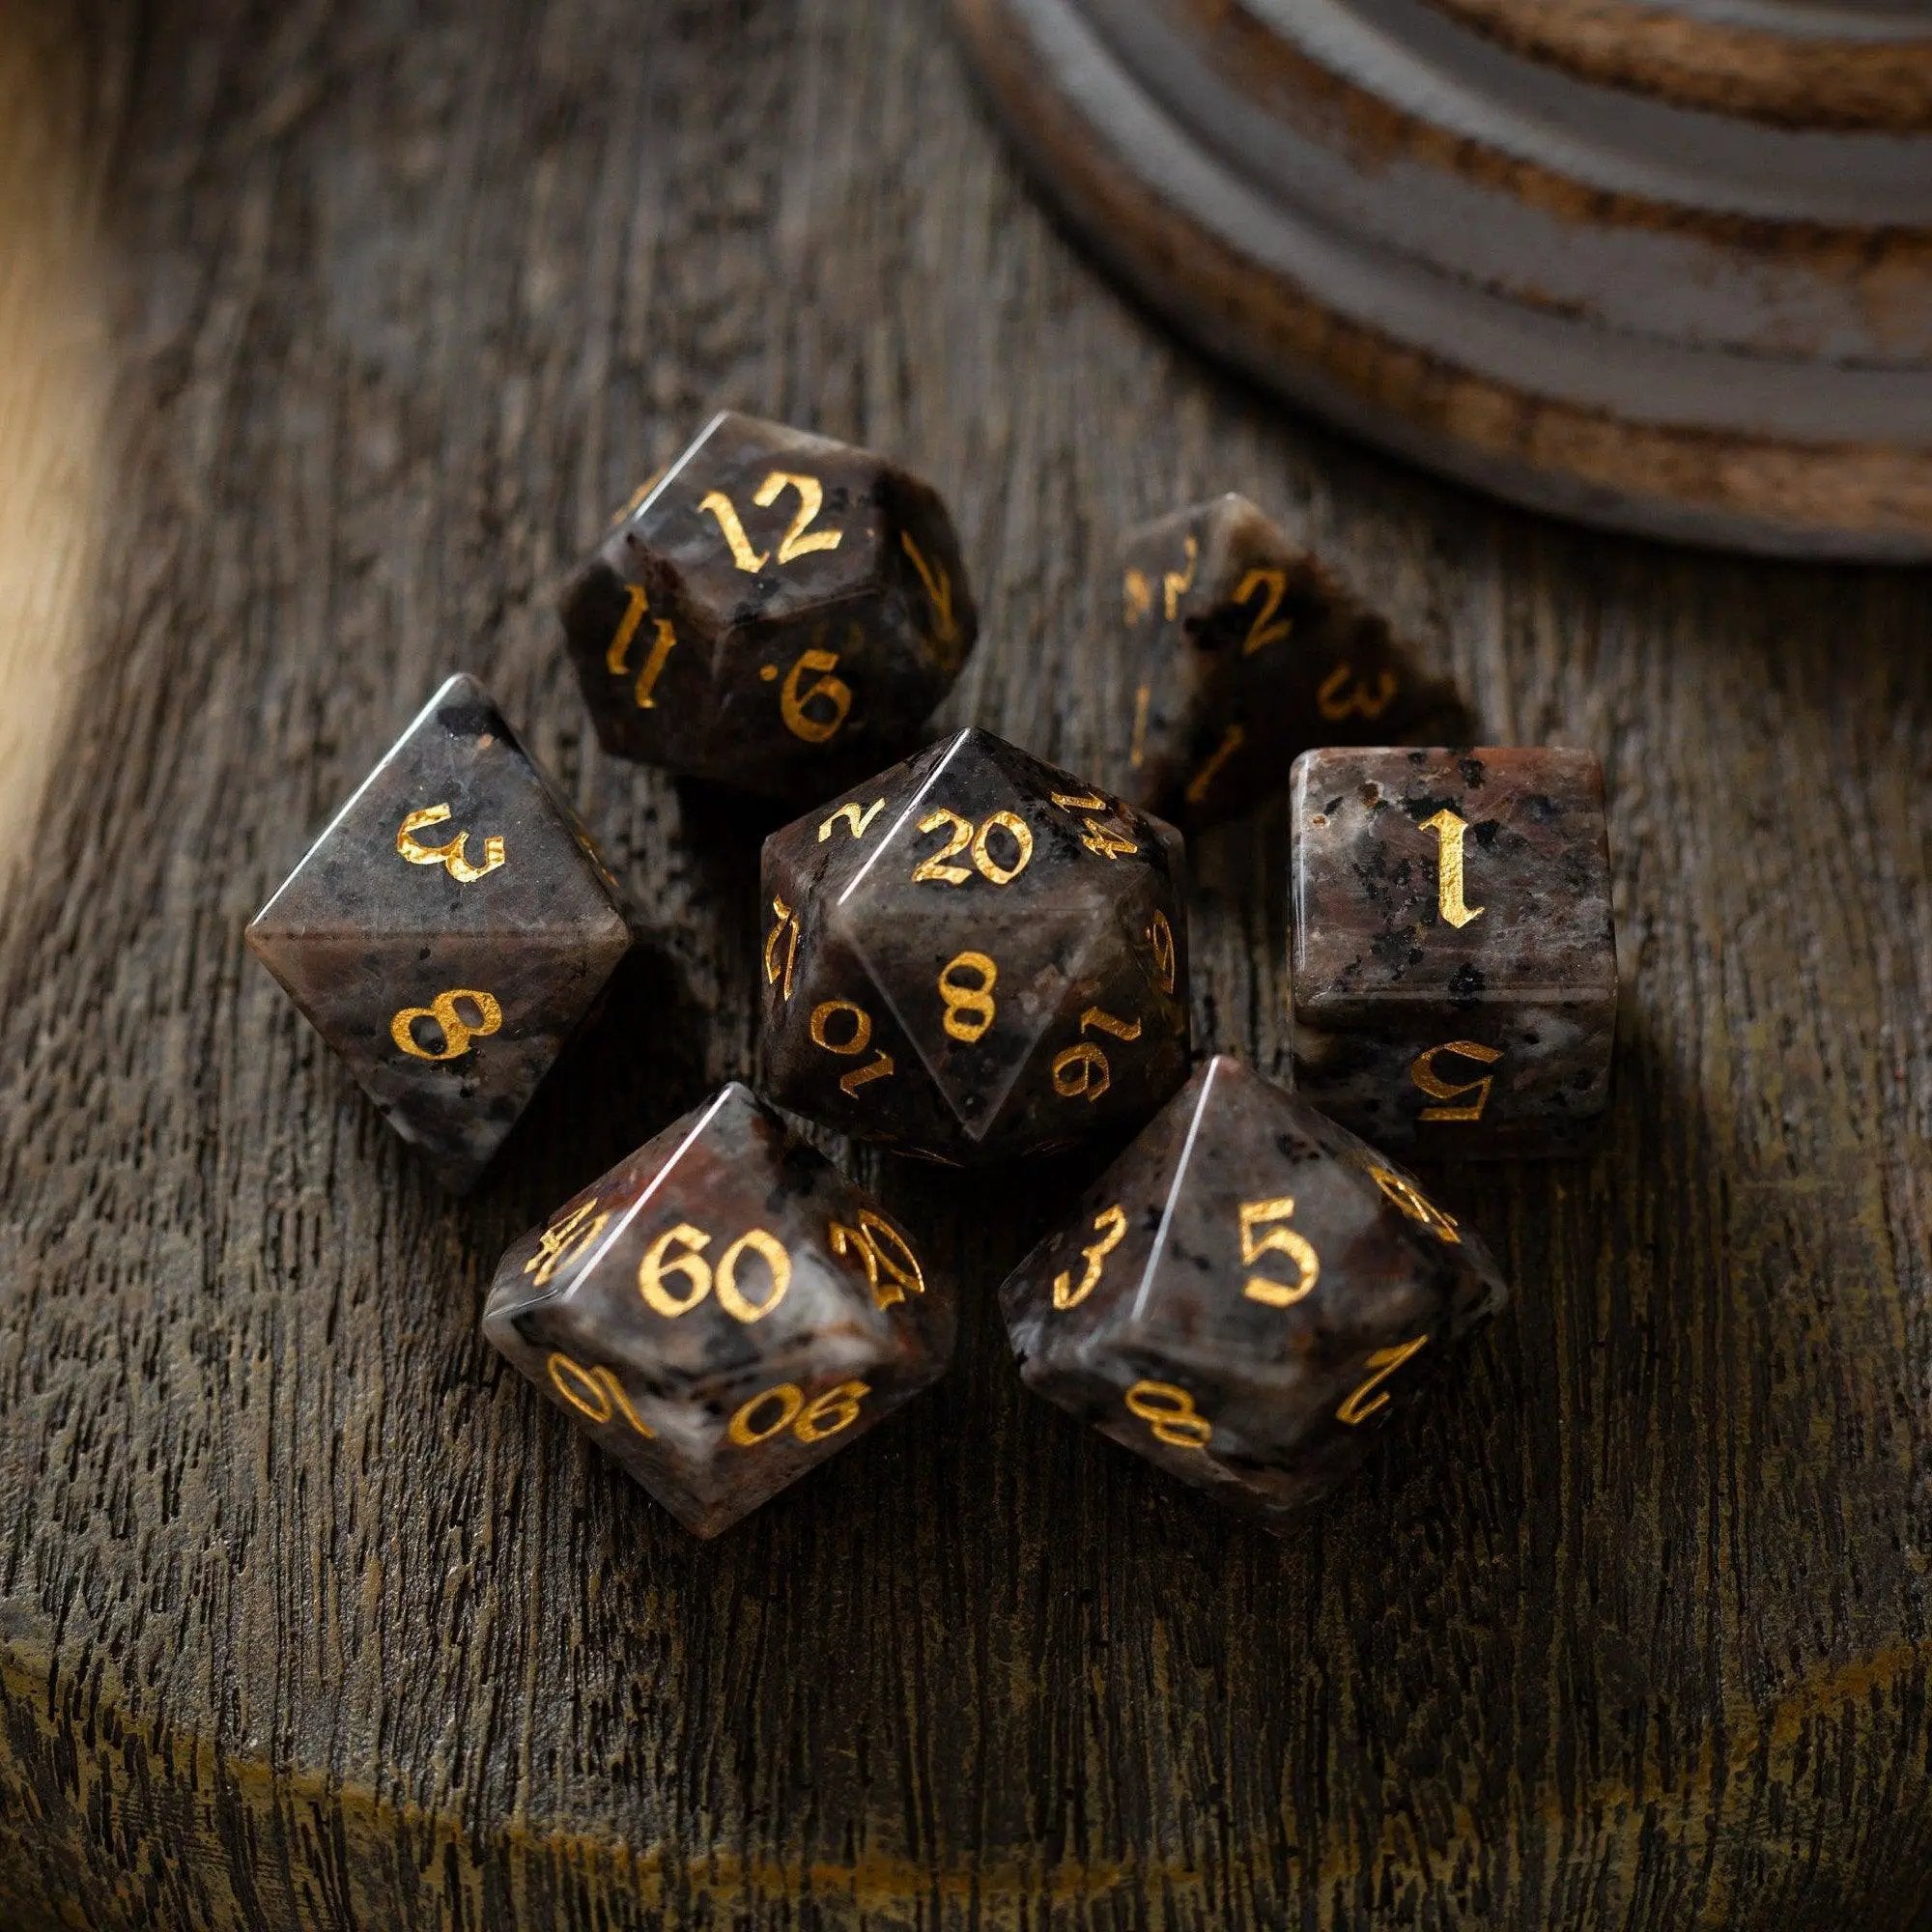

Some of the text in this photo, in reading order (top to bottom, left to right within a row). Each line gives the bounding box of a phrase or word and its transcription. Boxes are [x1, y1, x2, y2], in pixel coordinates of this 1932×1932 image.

[697, 469, 844, 574] 12
[606, 582, 678, 710] 11
[1233, 567, 1293, 657] 2
[1317, 665, 1398, 722] 3
[396, 802, 506, 884] 3
[817, 797, 886, 843] 2
[911, 807, 1035, 886] 20
[1050, 790, 1140, 862] 14
[1418, 808, 1486, 929] 1
[389, 987, 504, 1062] 8
[938, 950, 999, 1044] 8
[810, 999, 895, 1099] 10
[1410, 1039, 1505, 1122] 5
[638, 1221, 793, 1324] 60
[1052, 1203, 1128, 1312] 3
[1237, 1194, 1321, 1310] 5
[1124, 1378, 1213, 1451] 8
